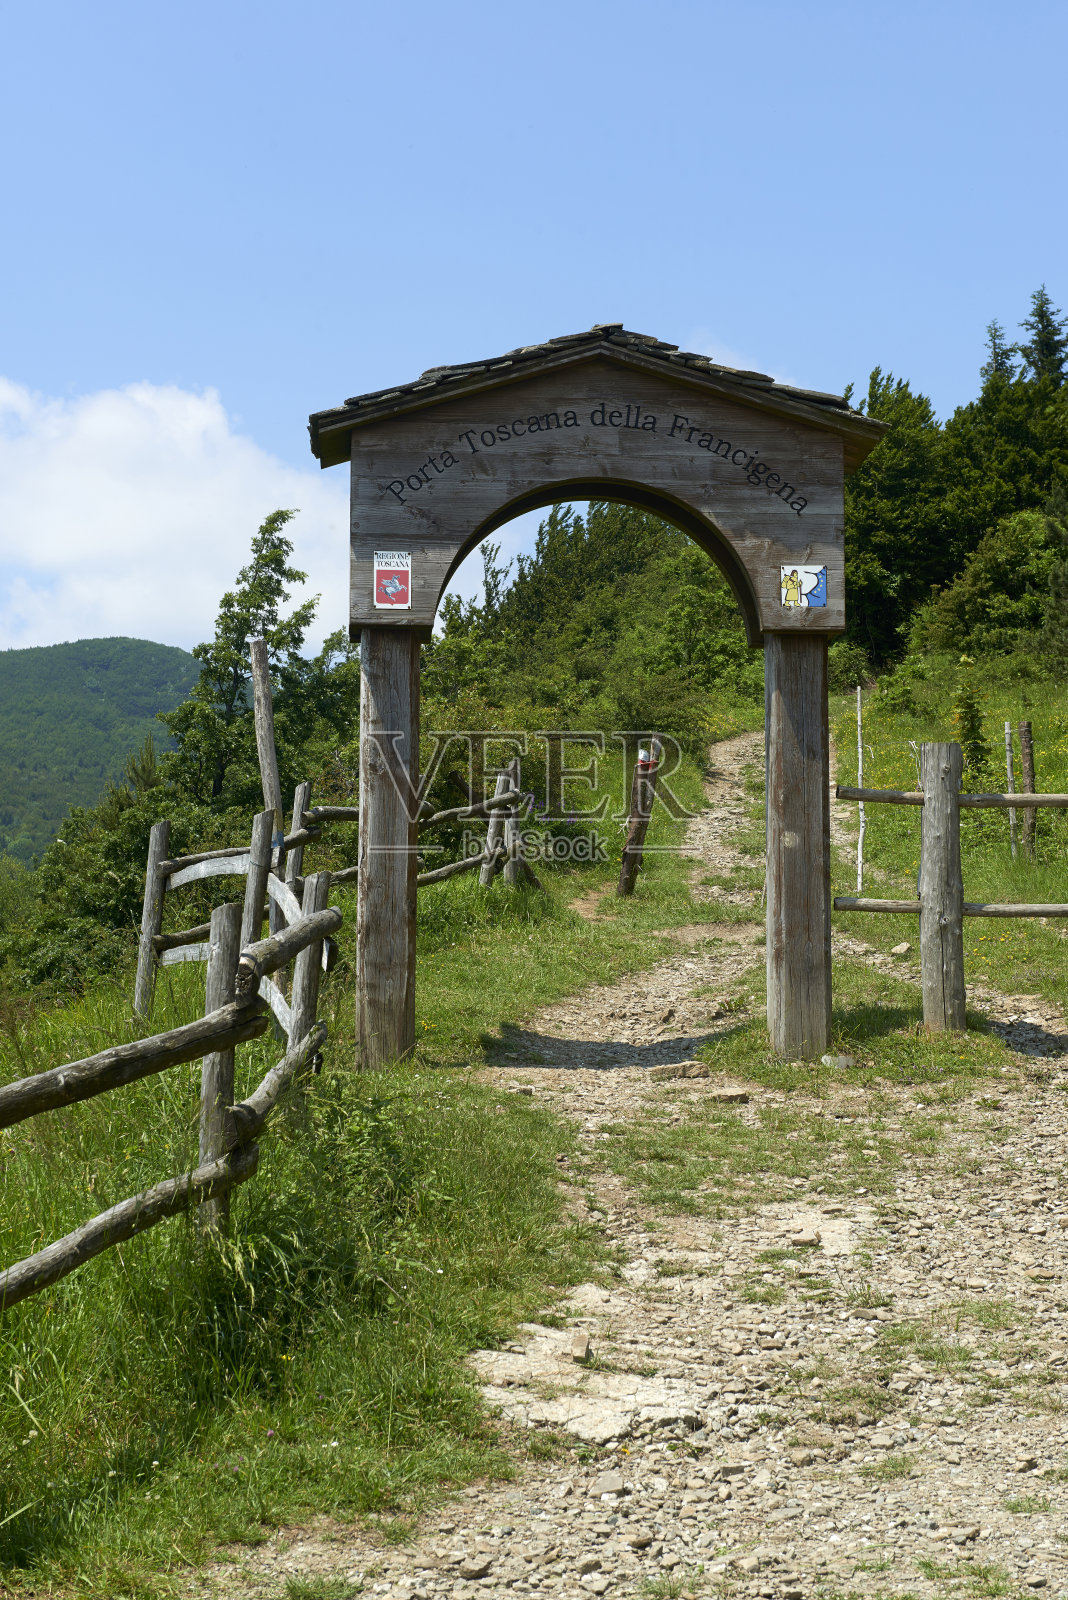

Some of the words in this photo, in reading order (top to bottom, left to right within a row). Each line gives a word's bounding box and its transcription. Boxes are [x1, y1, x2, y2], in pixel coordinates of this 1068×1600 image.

[385, 449, 460, 506] Porta
[458, 409, 581, 455] Toscana
[590, 402, 658, 433] della
[666, 413, 809, 517] Francigena
[376, 552, 410, 560] REGIONE
[376, 560, 410, 568] TOSCANA
